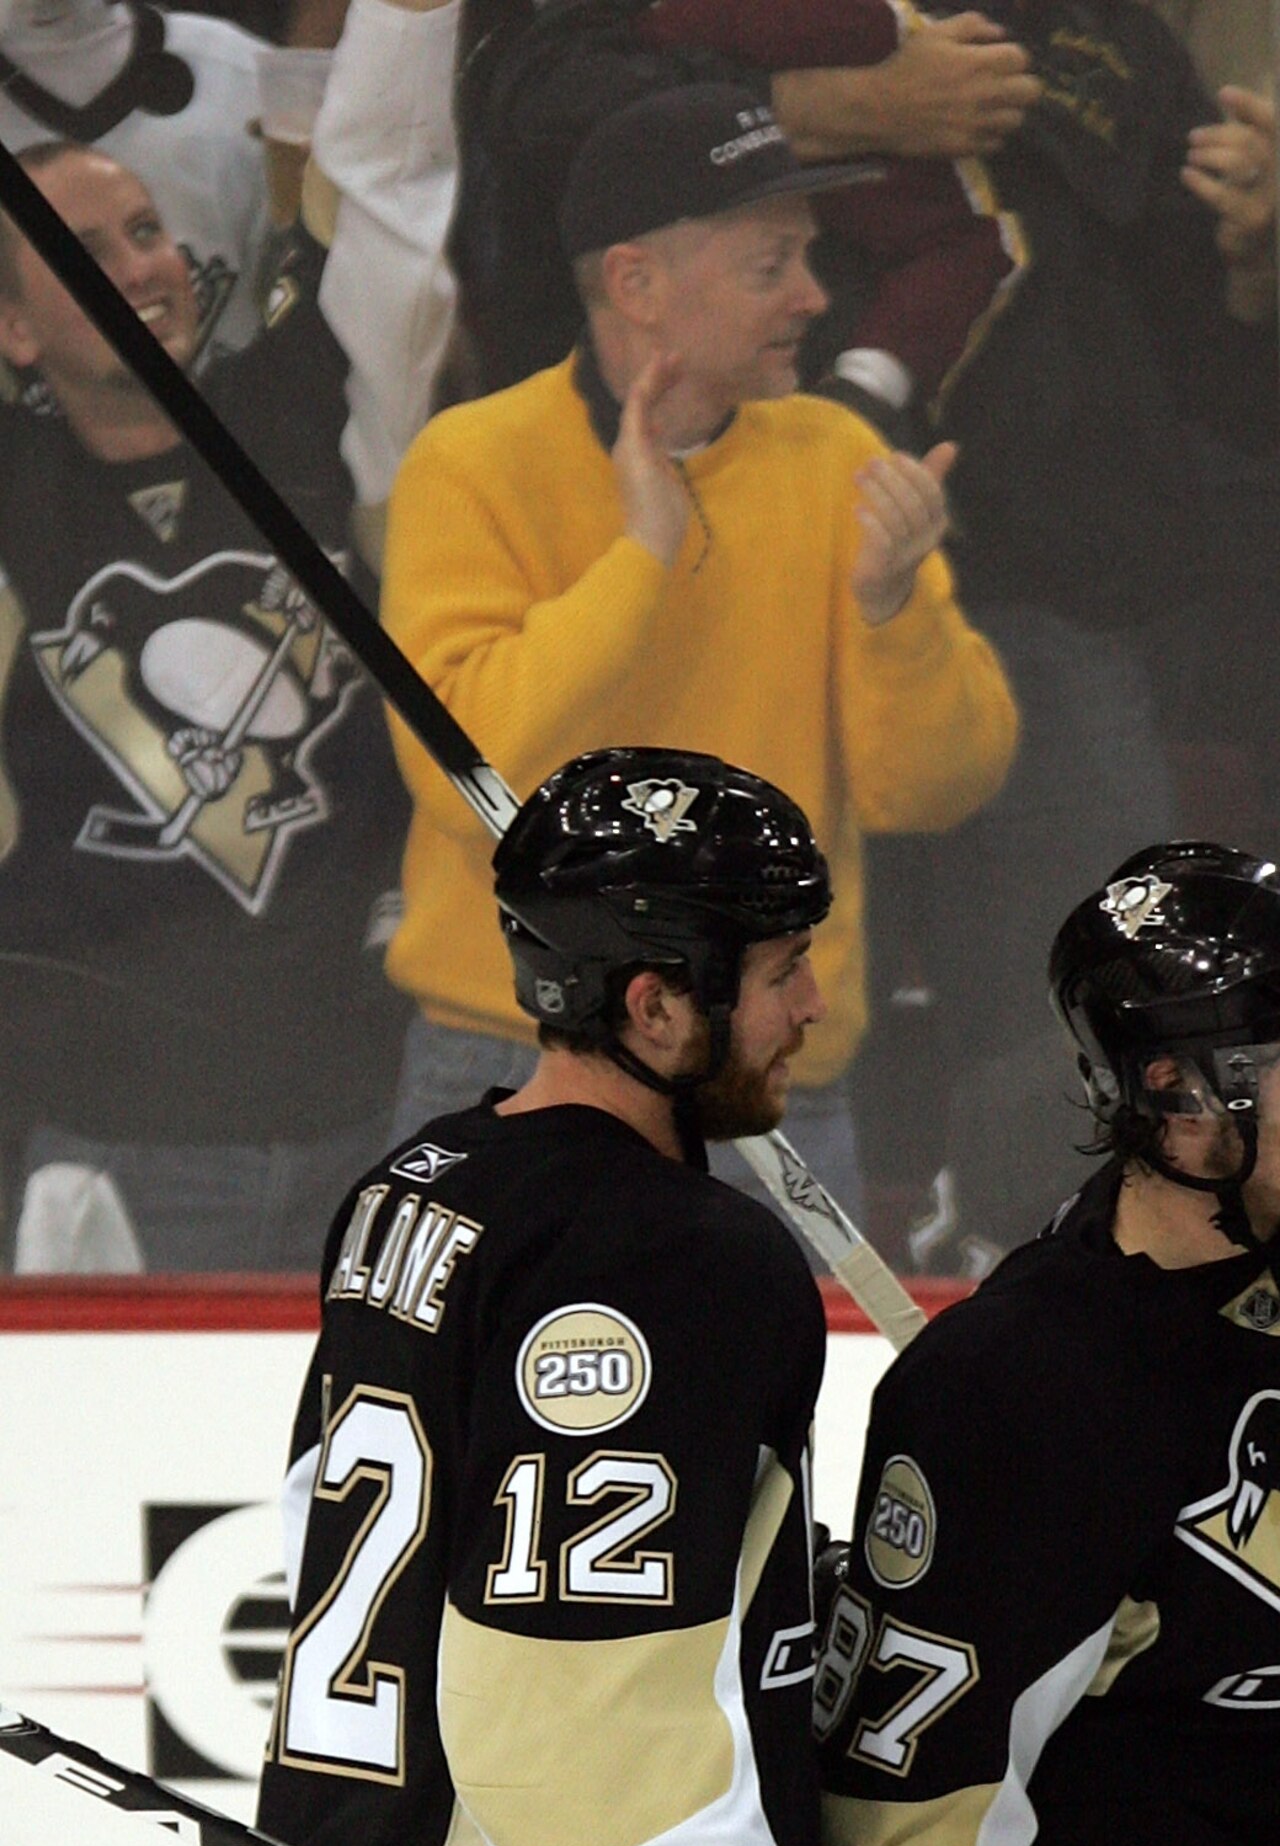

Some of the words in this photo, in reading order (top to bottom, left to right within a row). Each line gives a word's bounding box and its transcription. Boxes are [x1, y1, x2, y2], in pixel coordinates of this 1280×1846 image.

[534, 1349, 633, 1400] 250
[541, 1337, 625, 1350] PITTSBURGH
[278, 1376, 434, 1786] 2
[484, 1450, 679, 1605] 12
[873, 1492, 927, 1559] 250
[811, 1583, 981, 1779] 87
